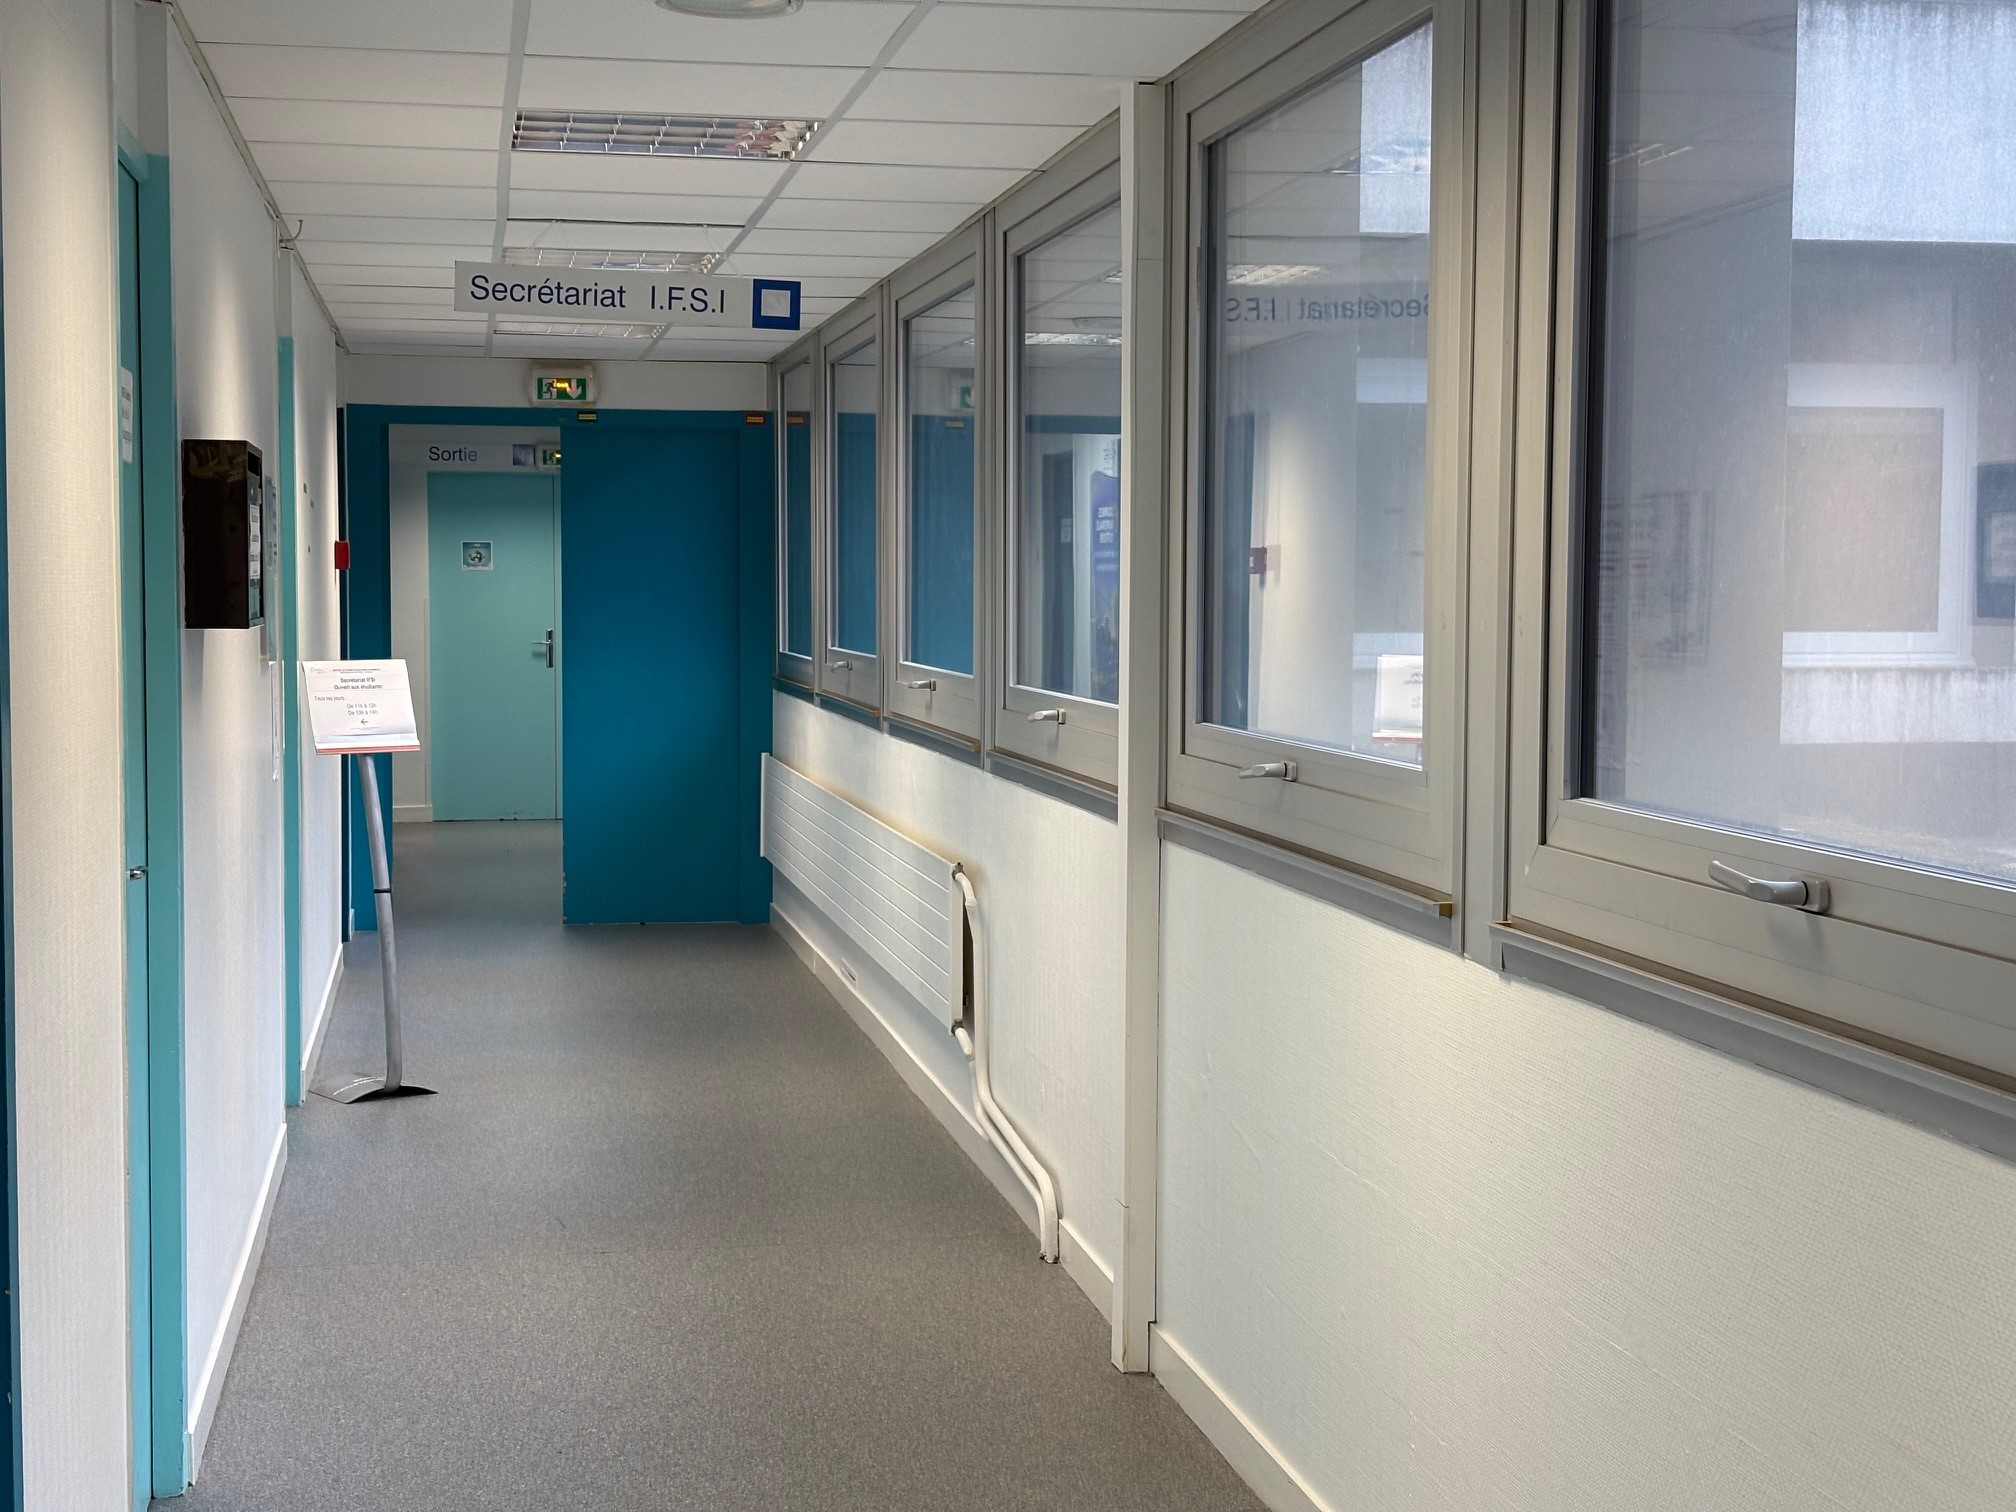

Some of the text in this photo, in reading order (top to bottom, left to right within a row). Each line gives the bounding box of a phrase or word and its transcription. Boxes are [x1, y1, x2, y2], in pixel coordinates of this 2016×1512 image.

[470, 274, 726, 314] Secrétariat I.F.S.I
[428, 446, 478, 462] Sortie
